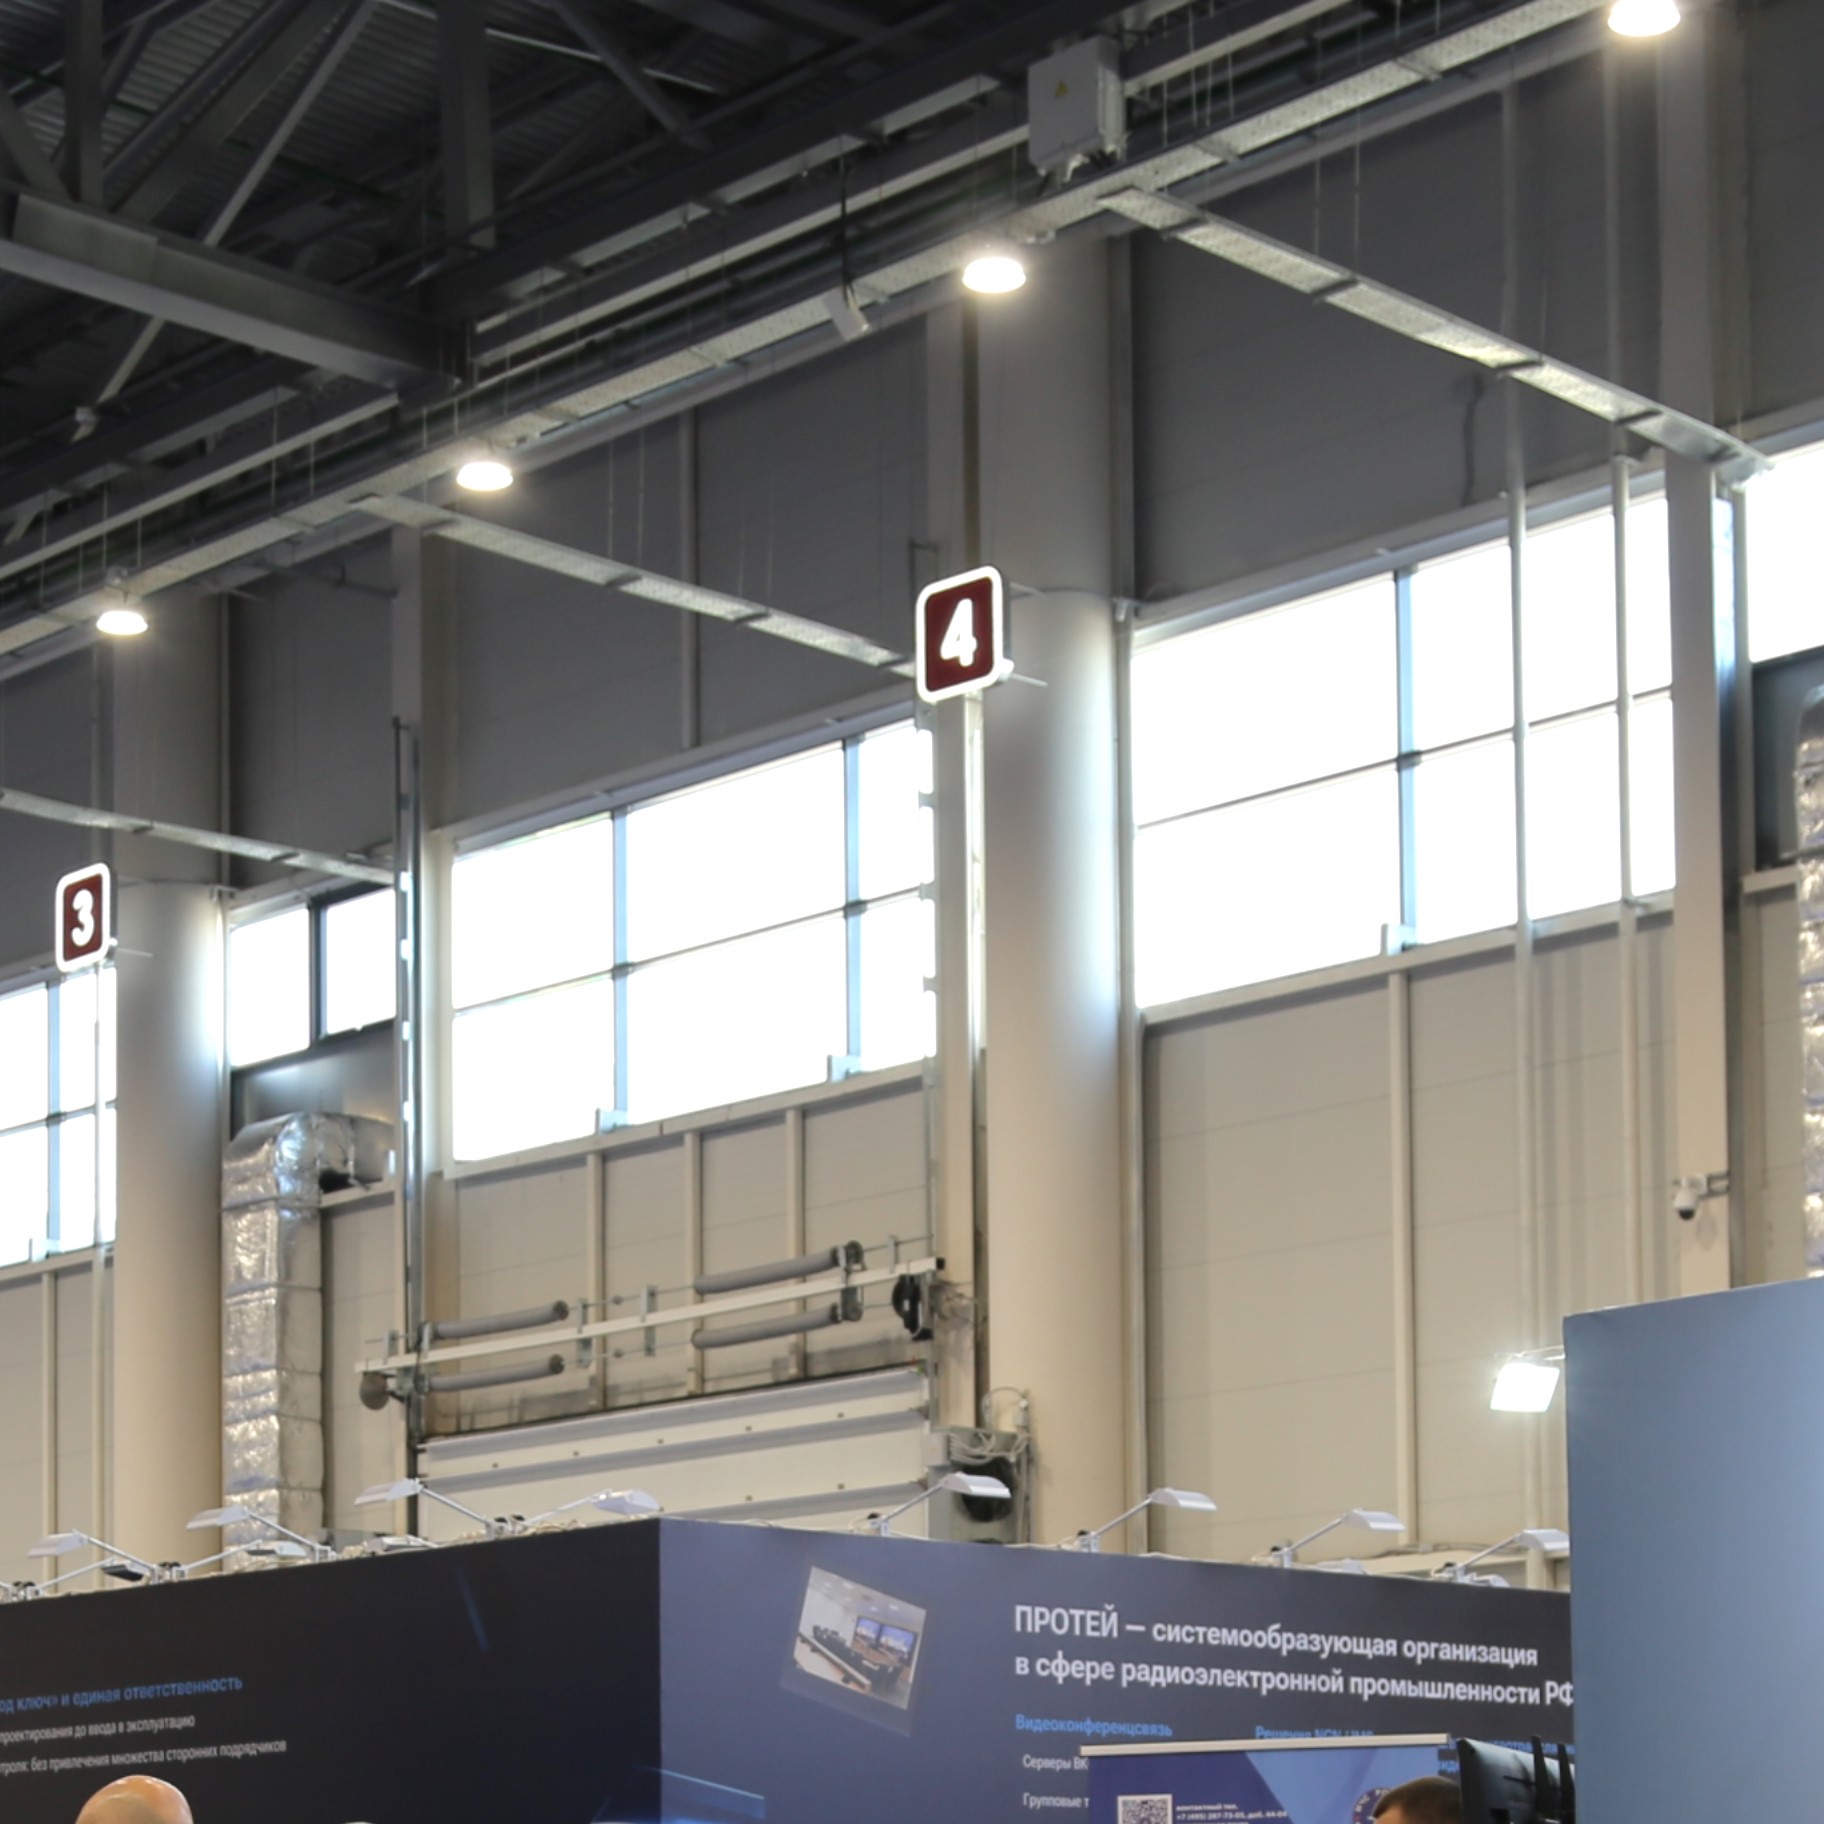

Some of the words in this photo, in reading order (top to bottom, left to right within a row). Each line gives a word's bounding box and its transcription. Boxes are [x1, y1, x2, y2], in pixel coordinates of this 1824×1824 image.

[940, 598, 978, 667] 4
[72, 889, 94, 947] 3
[1014, 1604, 1118, 1638] ПРОТЕЙ
[1152, 1621, 1397, 1658] системообразующая
[1402, 1640, 1539, 1667] организация
[61, 1694, 70, 1707] и
[72, 1688, 121, 1706] единая
[123, 1676, 243, 1701] ответственность
[1015, 1657, 1029, 1675] в
[1035, 1652, 1115, 1686] сфере
[1120, 1660, 1344, 1696] радиоэлектронной
[1349, 1671, 1540, 1705] промышленности
[0, 1725, 73, 1745] проектирования
[126, 1714, 196, 1735] эксплуатацию
[1016, 1714, 1173, 1737] Видеоконференцсвязь
[31, 1756, 48, 1772] без
[50, 1754, 109, 1773] привлечения
[166, 1746, 218, 1763] сторонних
[1023, 1754, 1071, 1771] Серверы
[1023, 1792, 1082, 1809] Групповые
